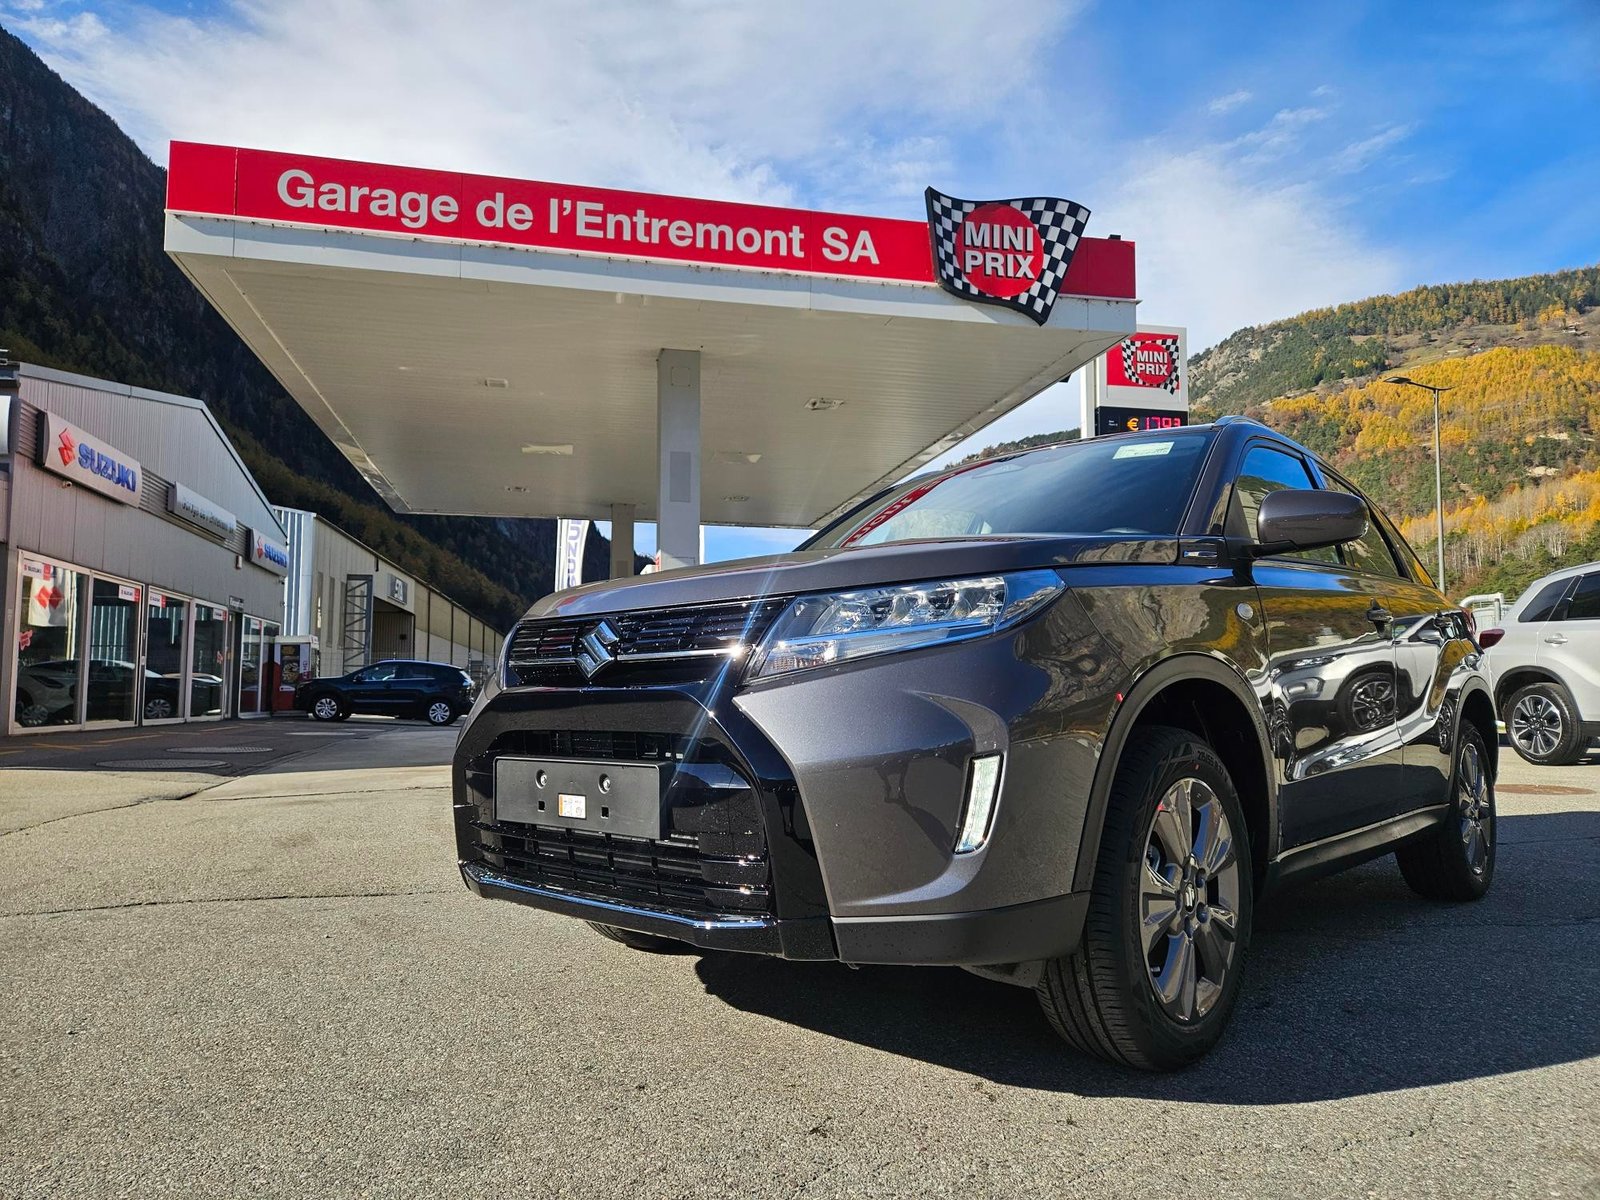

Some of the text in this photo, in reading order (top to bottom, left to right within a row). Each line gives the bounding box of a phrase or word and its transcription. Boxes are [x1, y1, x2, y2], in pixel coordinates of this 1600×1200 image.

[276, 168, 880, 265] Garage de l'Entremont SA
[964, 221, 1034, 252] MINI
[964, 250, 1036, 279] PRIX
[1136, 350, 1168, 363] MINI
[1136, 362, 1168, 376] PRIX
[78, 442, 137, 493] SUZUKI
[263, 543, 288, 568] SUZUKI
